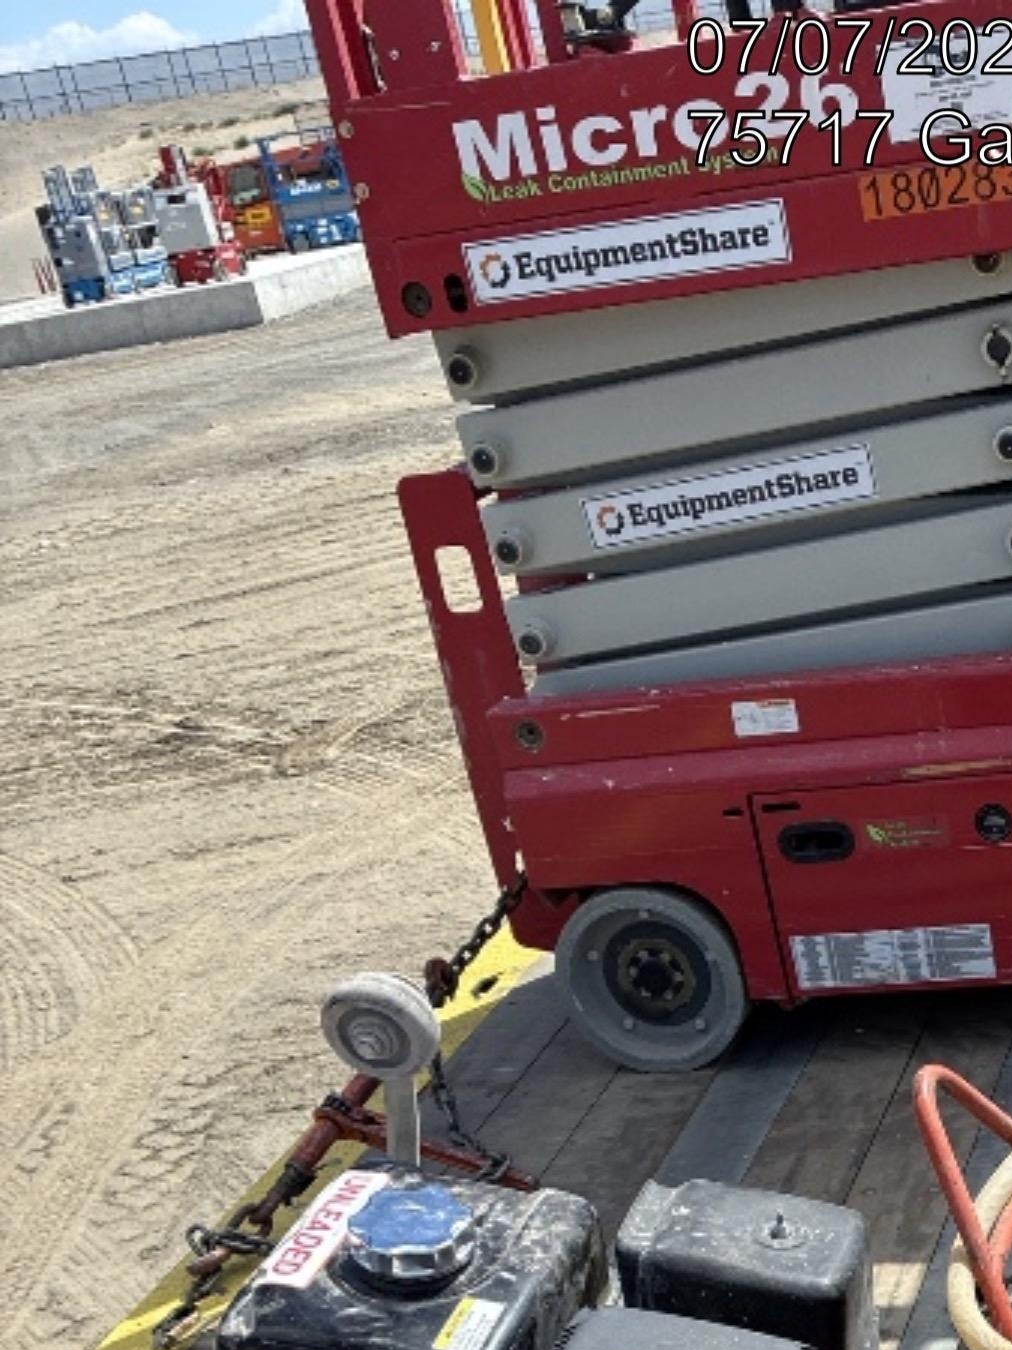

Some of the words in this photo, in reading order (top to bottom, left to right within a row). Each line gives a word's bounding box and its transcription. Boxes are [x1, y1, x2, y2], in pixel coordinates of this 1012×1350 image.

[487, 179, 543, 202] Leak
[548, 157, 692, 195] Containment
[513, 222, 771, 282] EquipmentShare
[628, 463, 860, 529] EquipmentShare
